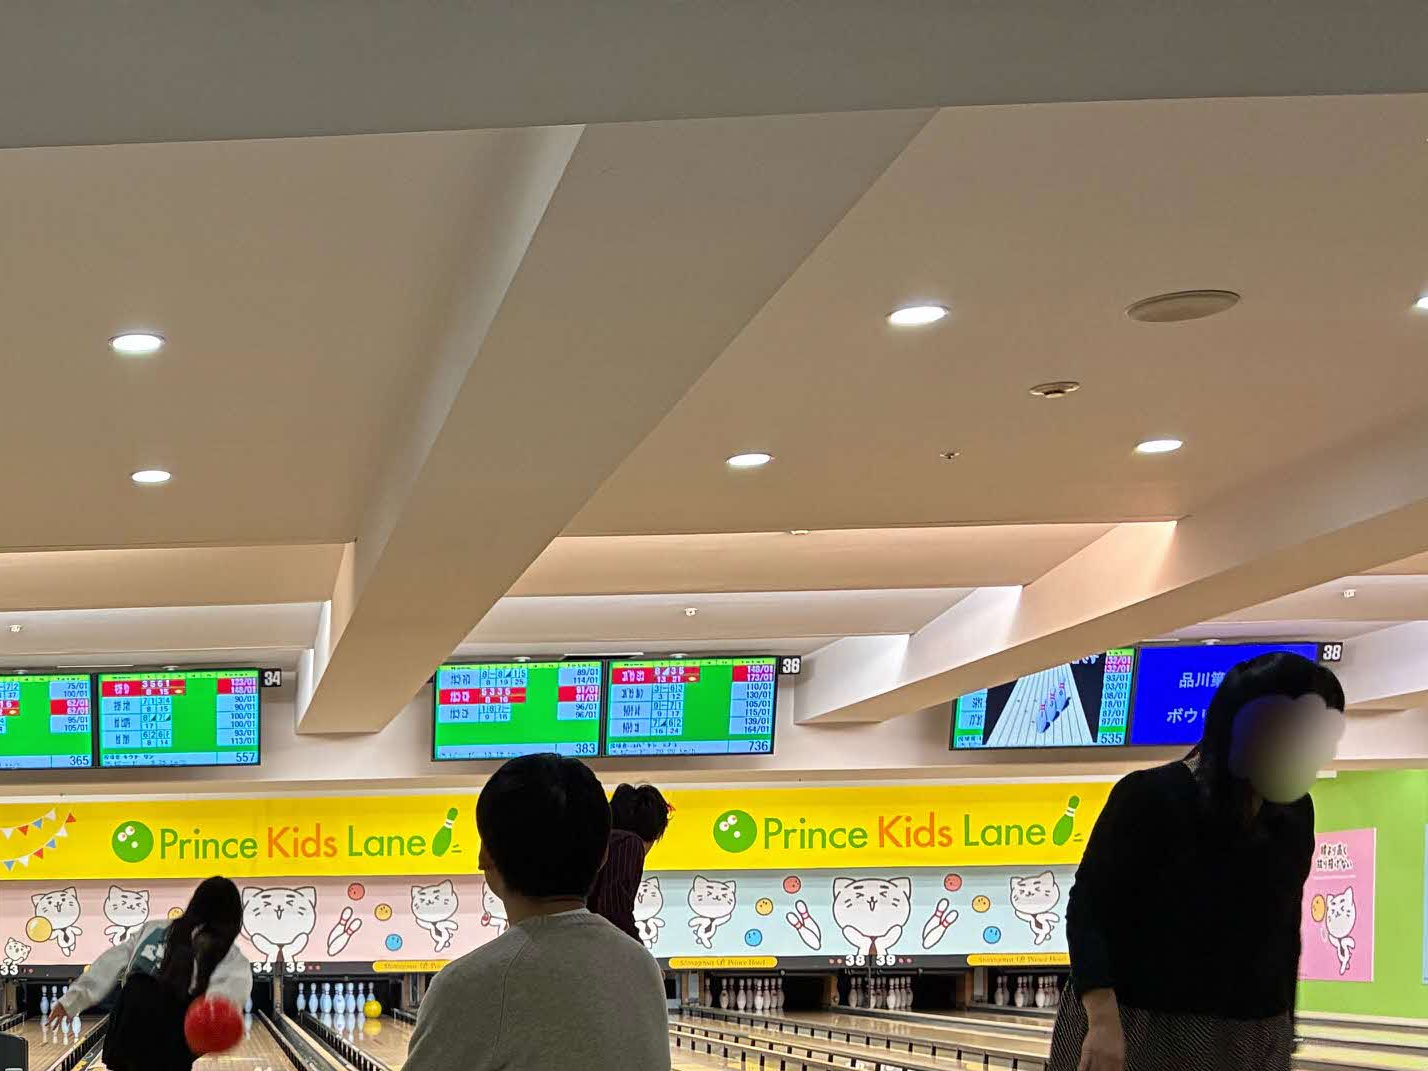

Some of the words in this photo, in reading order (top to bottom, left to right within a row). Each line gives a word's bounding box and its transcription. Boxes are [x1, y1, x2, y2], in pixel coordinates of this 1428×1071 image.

[1323, 644, 1341, 660] 38
[264, 671, 281, 686] 34
[1101, 733, 1121, 743] 535
[575, 744, 596, 753] 383
[749, 741, 768, 751] 736
[70, 756, 89, 765] 365
[236, 752, 255, 762] 557
[764, 818, 868, 849] Prince
[878, 812, 953, 848] Kids
[964, 814, 1046, 846] Lane
[160, 828, 258, 860] Prince
[267, 823, 337, 858] Kids
[348, 825, 426, 857] Lane
[845, 955, 866, 966] 38
[876, 955, 896, 966] 39
[0, 966, 18, 975] 33
[253, 962, 272, 973] 34
[286, 962, 306, 973] 35
